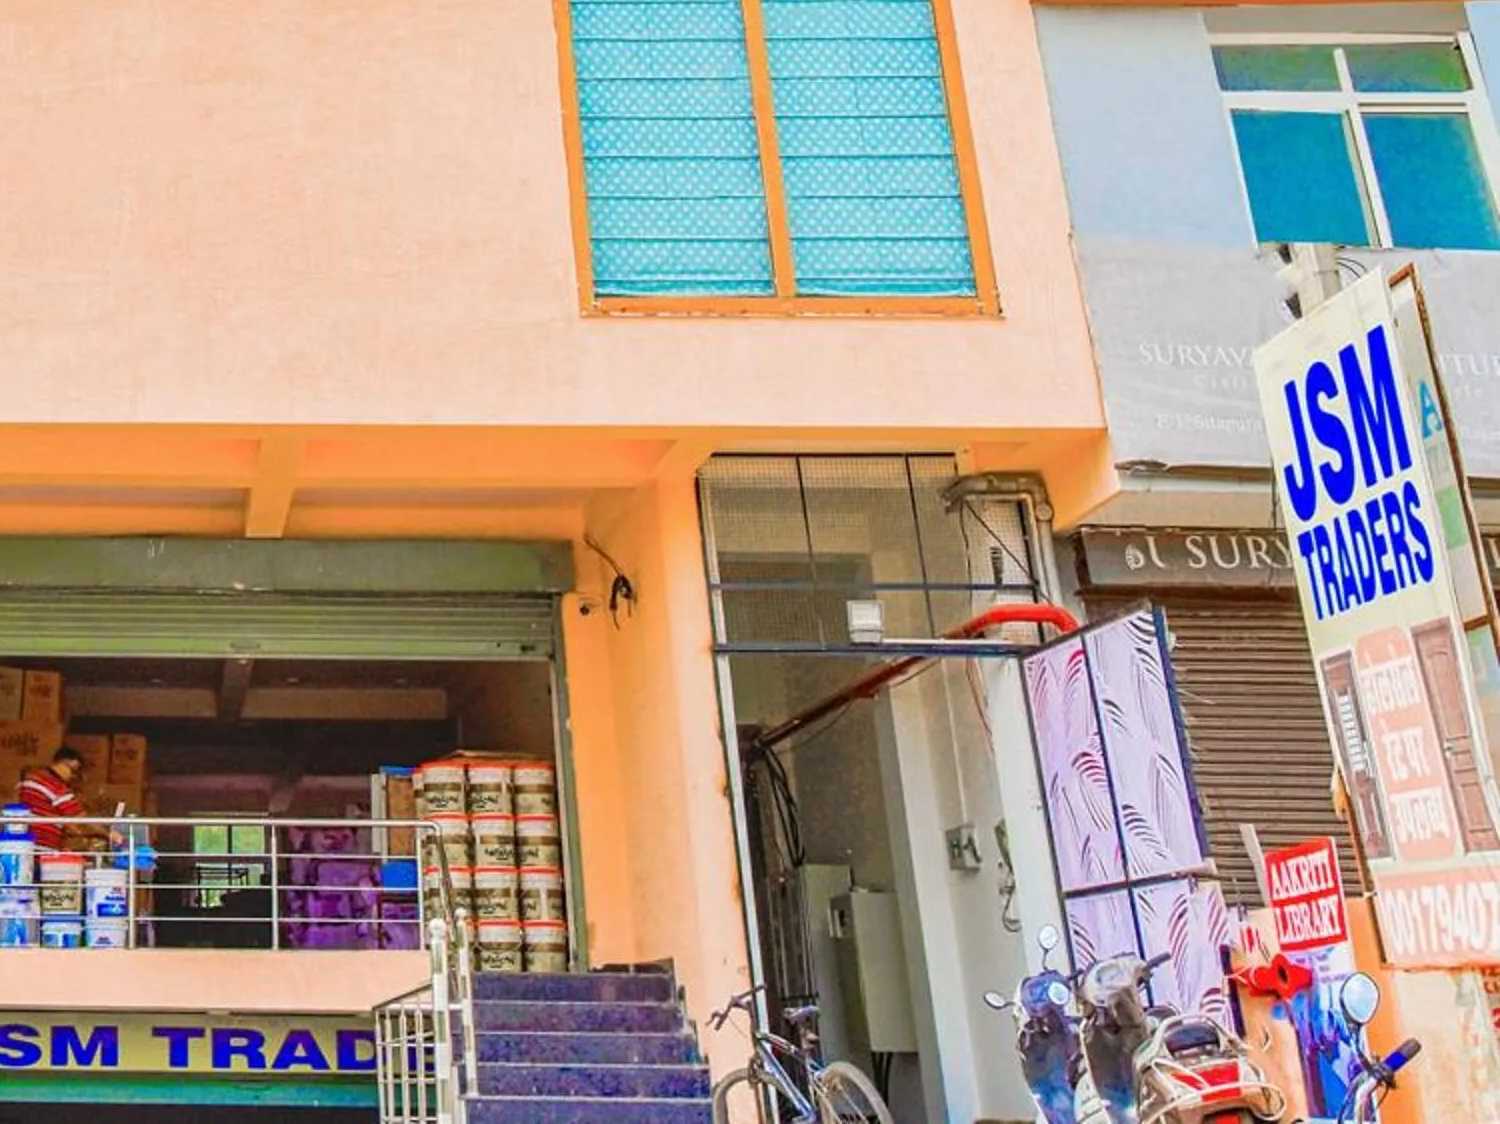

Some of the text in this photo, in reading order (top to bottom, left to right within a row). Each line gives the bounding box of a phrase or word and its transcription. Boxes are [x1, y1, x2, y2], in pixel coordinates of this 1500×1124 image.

[1139, 340, 1255, 366] SURYAV
[1283, 323, 1413, 523] JSM
[1297, 480, 1434, 621] TRADERS
[1271, 848, 1335, 900] AAKRITI
[1274, 894, 1341, 943] LIBRARY
